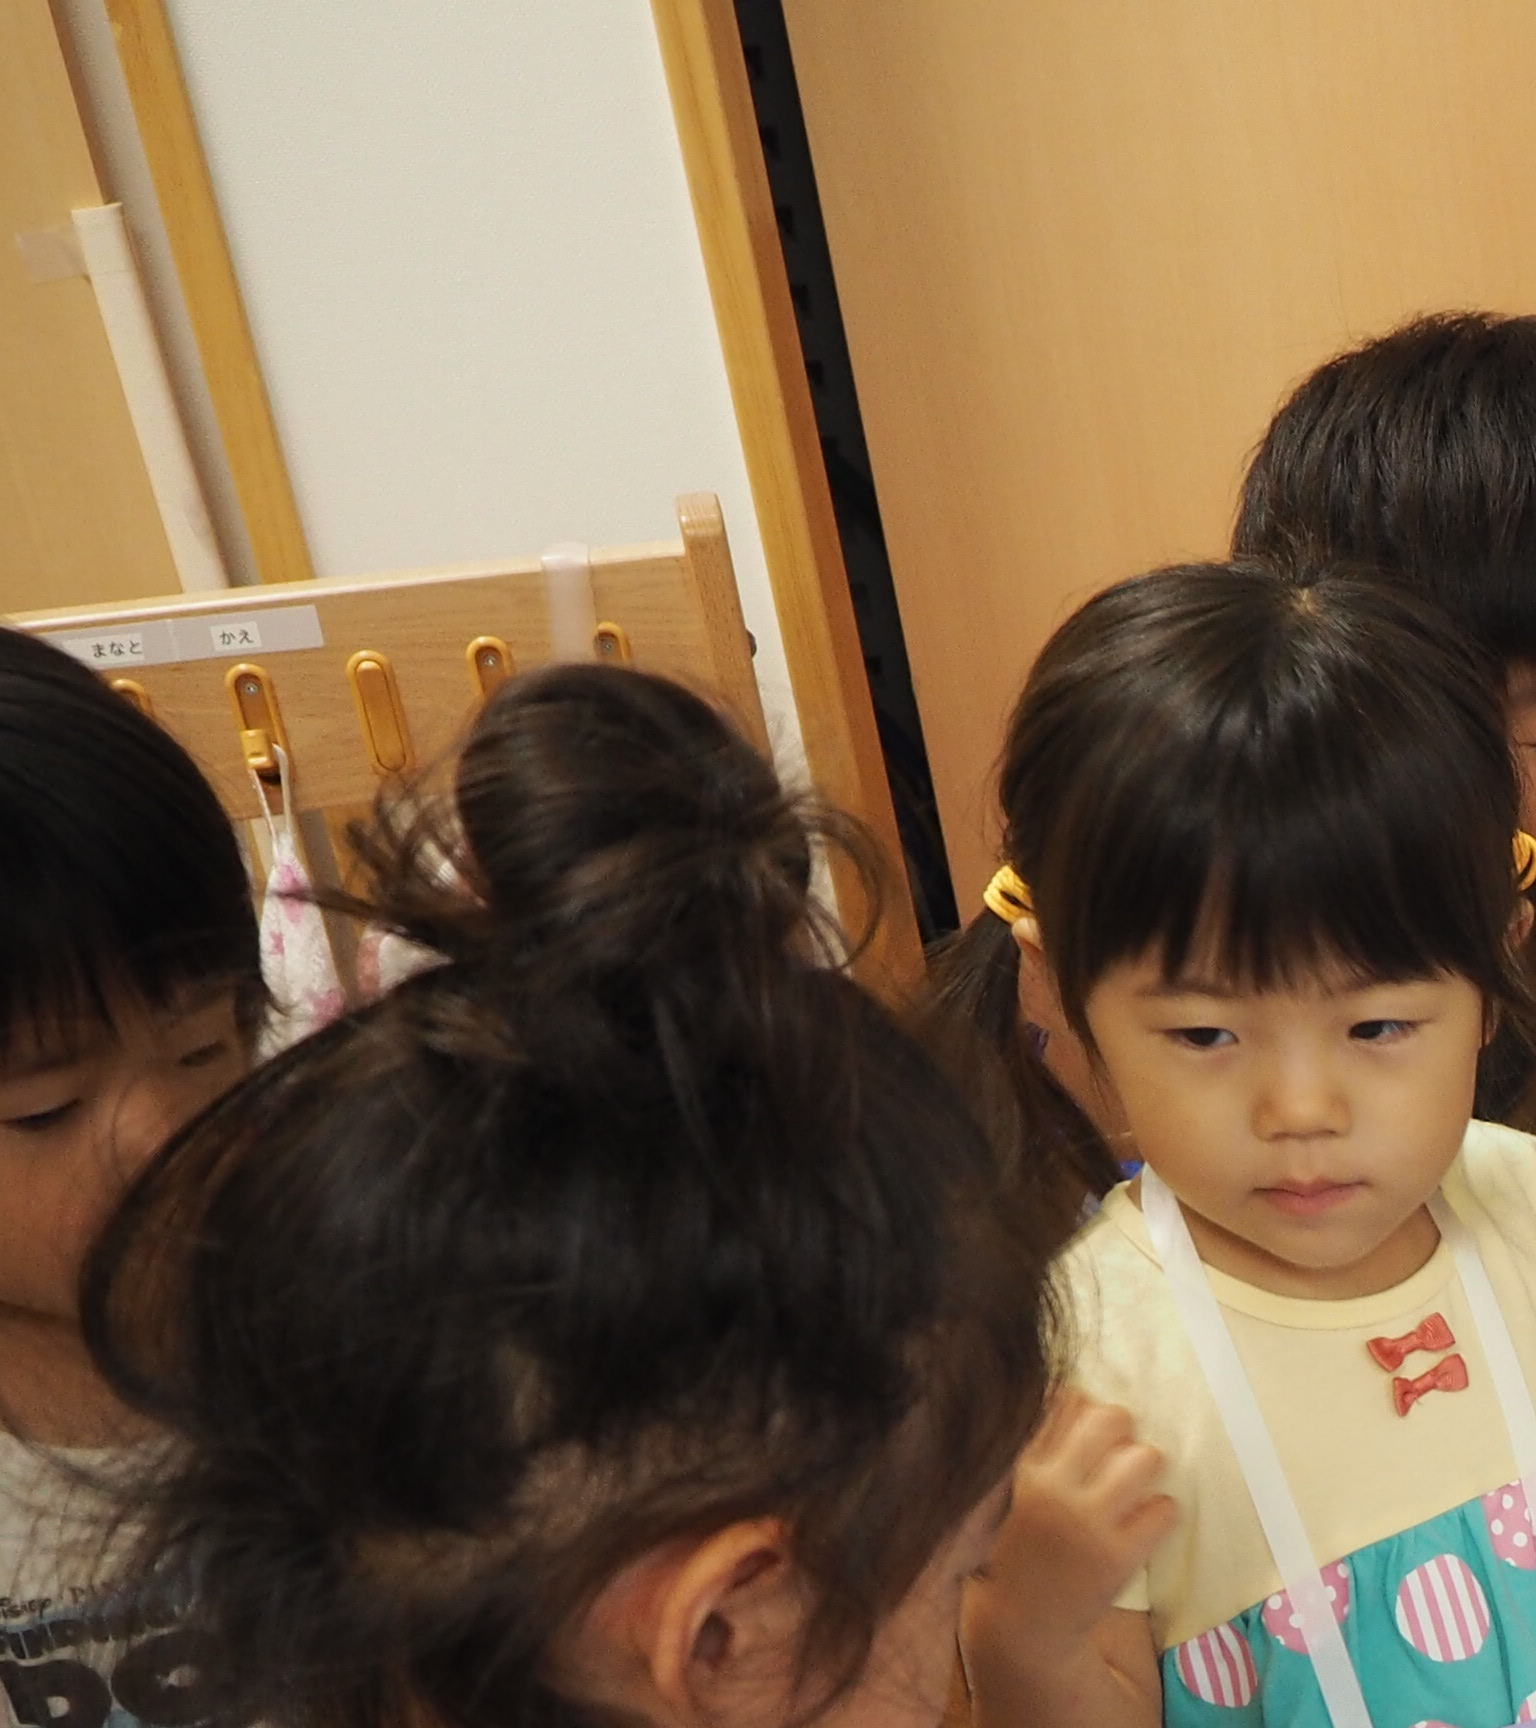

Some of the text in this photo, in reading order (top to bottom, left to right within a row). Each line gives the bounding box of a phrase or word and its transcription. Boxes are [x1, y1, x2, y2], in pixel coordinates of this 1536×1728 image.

[219, 629, 254, 645] かえ
[92, 640, 142, 659] まなと
